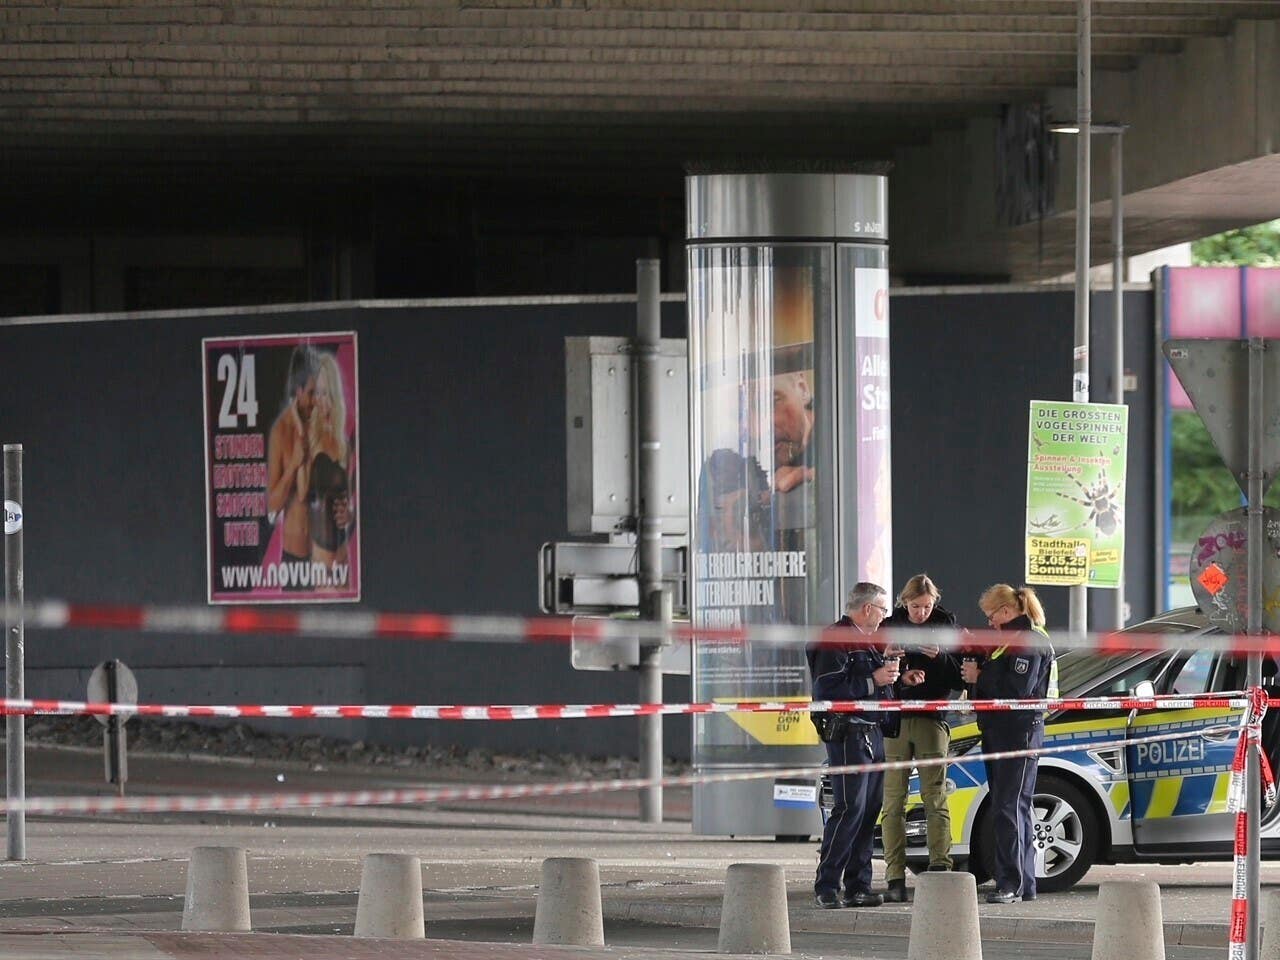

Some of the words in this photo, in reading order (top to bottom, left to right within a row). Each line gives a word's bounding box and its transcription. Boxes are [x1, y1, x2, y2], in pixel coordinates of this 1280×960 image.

[217, 354, 258, 428] 24
[1038, 409, 1058, 418] DIE
[1036, 421, 1122, 433] VOGELSPINNEN
[1052, 433, 1075, 442] DER
[1080, 435, 1107, 444] WELT
[1030, 555, 1086, 566] 25.05.25
[221, 561, 348, 588] www.novum.tv
[1030, 564, 1085, 577] Sonntag
[1136, 739, 1204, 766] POLIZEI
